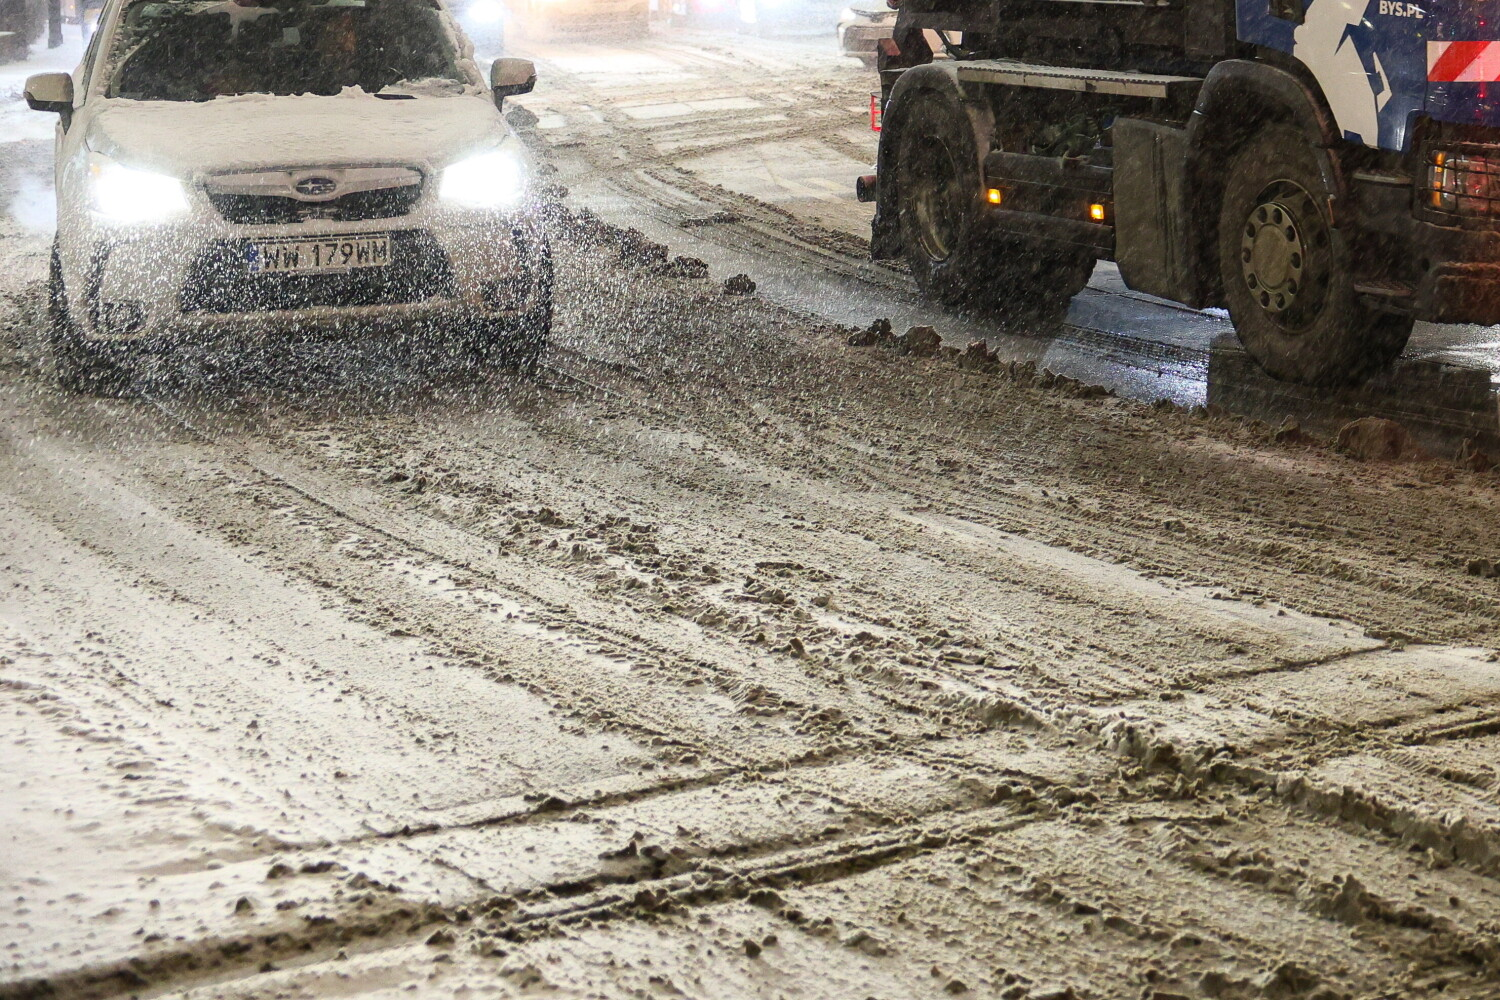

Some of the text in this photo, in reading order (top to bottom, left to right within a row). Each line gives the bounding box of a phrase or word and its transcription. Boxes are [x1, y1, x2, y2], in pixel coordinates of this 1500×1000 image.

[1379, 0, 1424, 19] BYS.PL
[264, 240, 387, 269] WW 179WM
